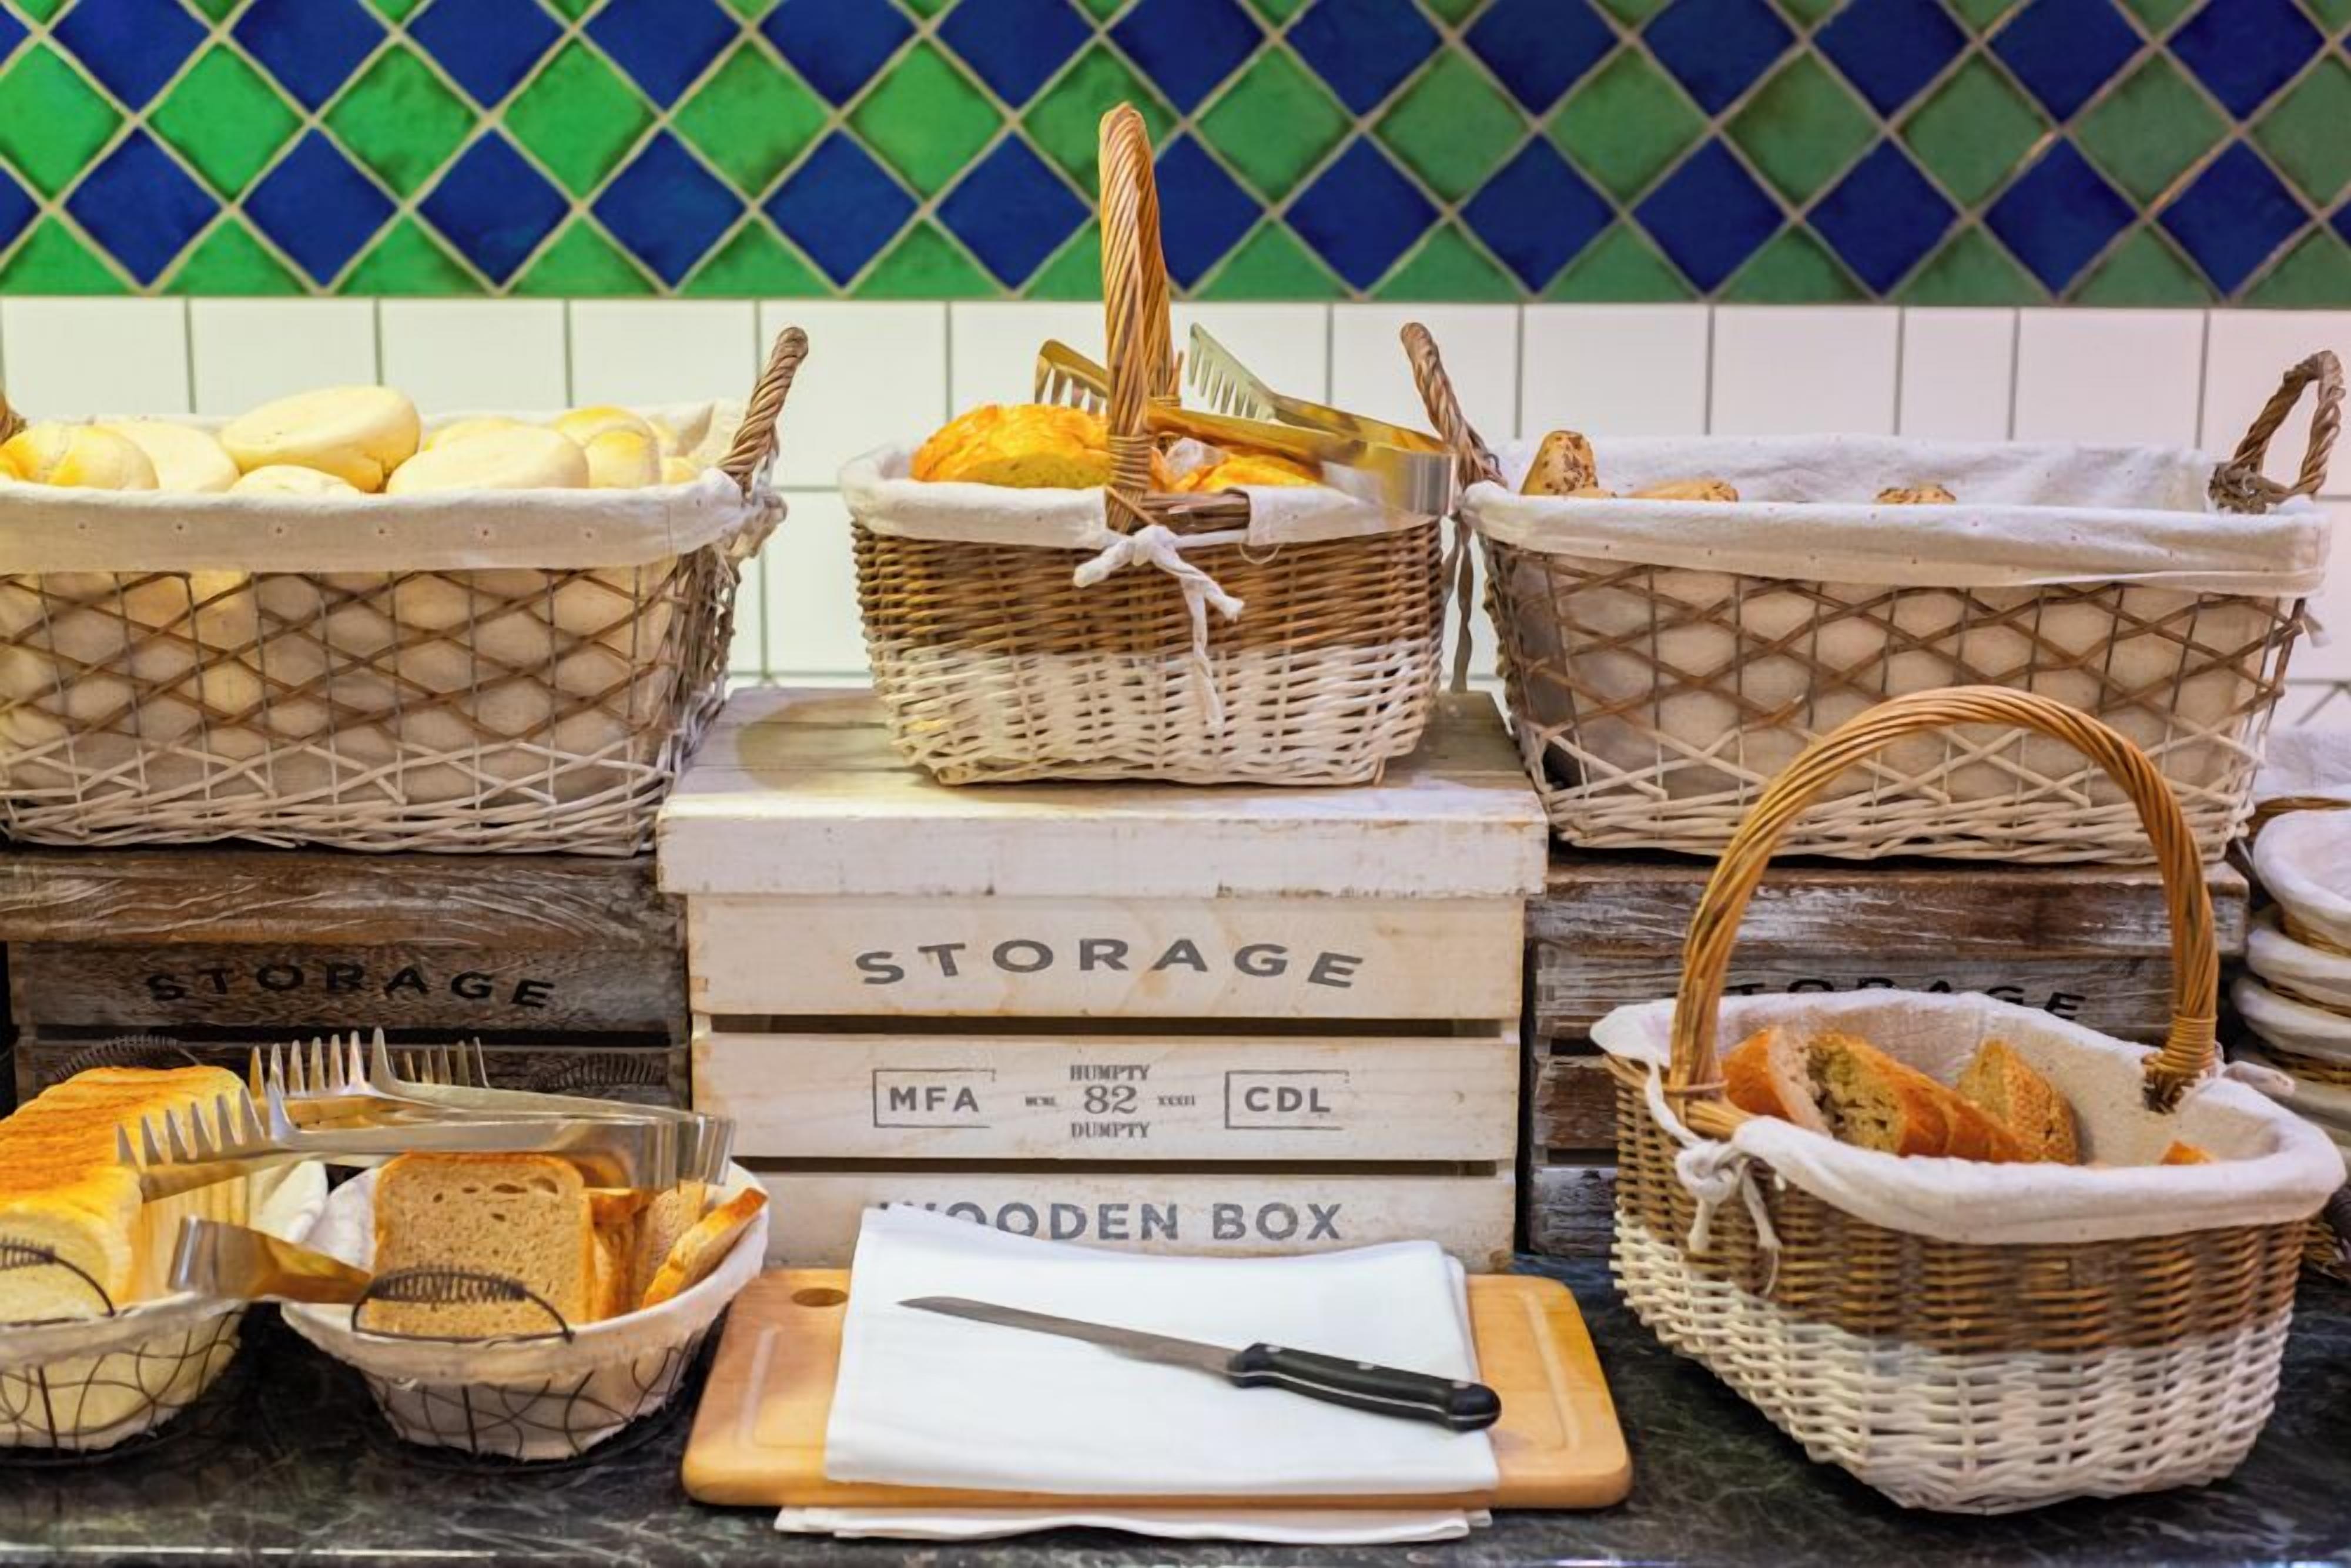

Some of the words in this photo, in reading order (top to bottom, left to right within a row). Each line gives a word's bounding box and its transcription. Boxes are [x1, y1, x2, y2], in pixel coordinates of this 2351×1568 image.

[855, 939, 1364, 988] STORAGE
[146, 963, 555, 1009] STORAGE
[1070, 1064, 1150, 1081] HUMPTY
[889, 1086, 980, 1113] MFA
[1083, 1084, 1138, 1114] 82
[1244, 1085, 1331, 1113] CDL
[1070, 1121, 1150, 1138] DUMPTY
[880, 1202, 1179, 1241] ODEN
[1212, 1203, 1342, 1241] BOX
